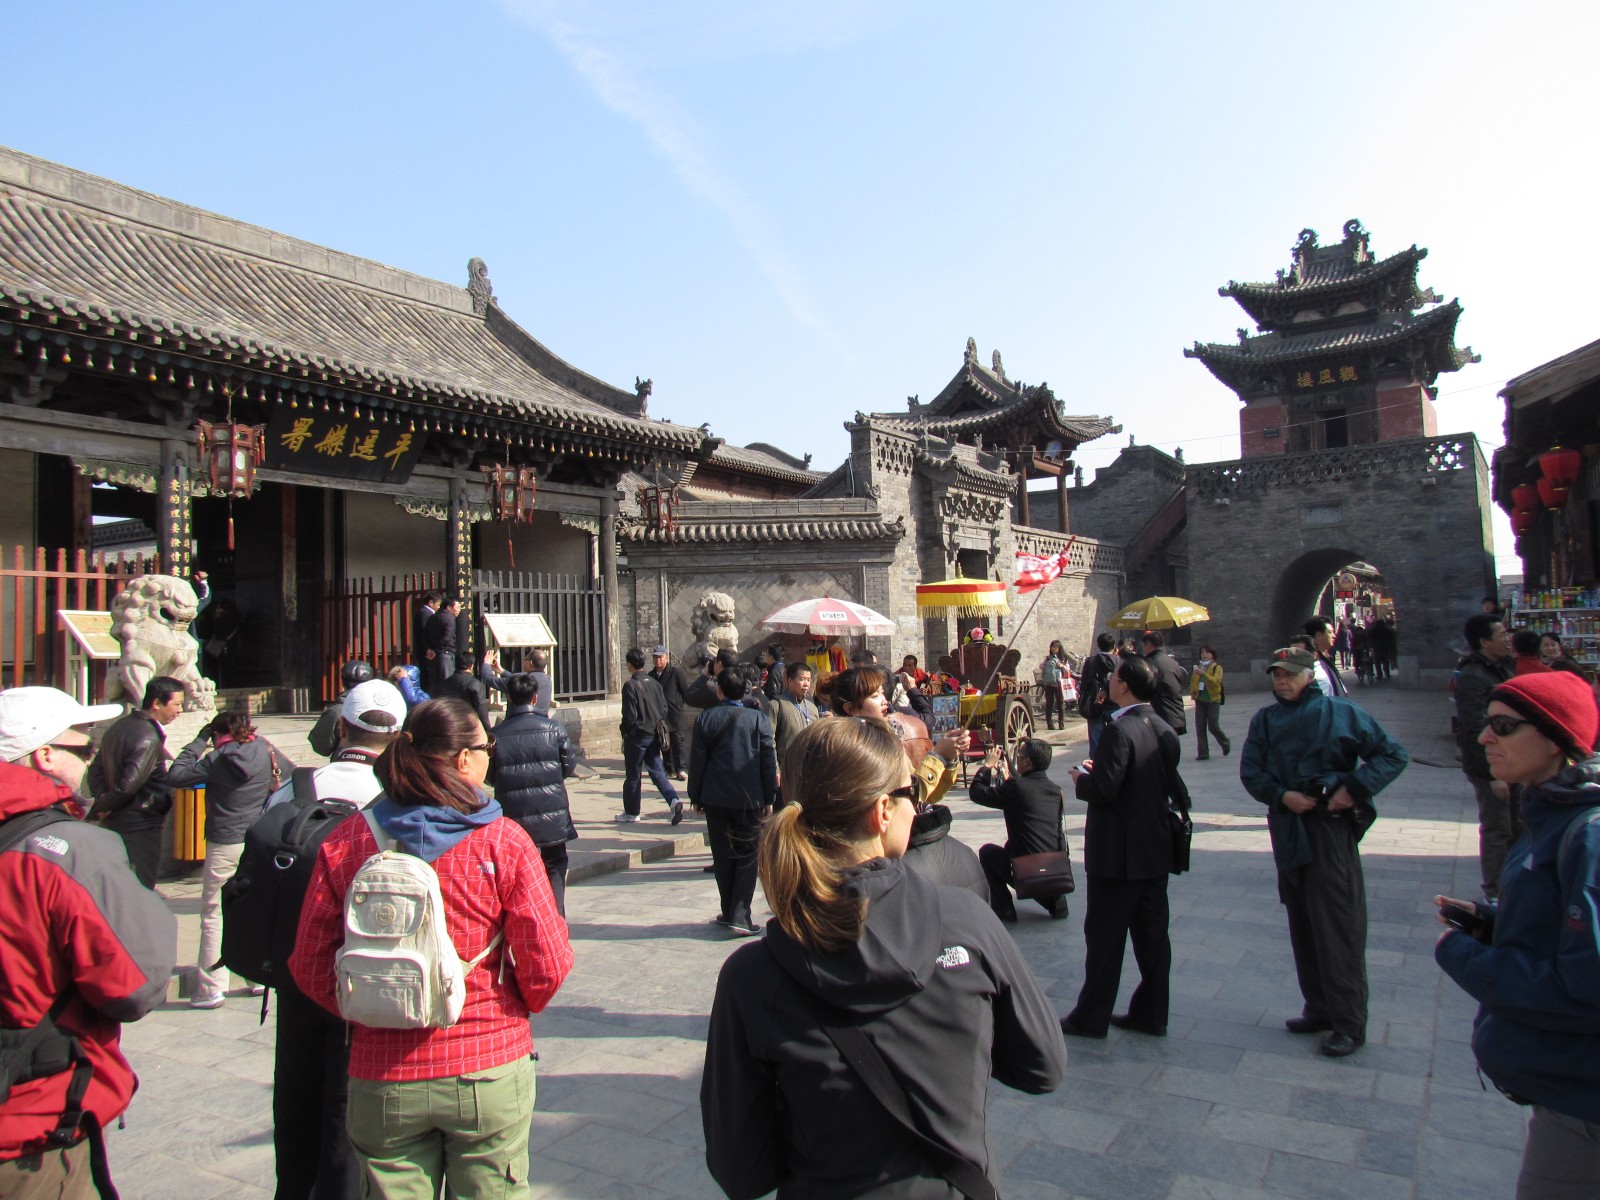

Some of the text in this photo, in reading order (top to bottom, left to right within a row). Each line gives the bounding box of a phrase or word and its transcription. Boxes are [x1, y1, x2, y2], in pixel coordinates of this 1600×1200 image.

[342, 752, 366, 761] Canon
[943, 947, 958, 955] THE
[936, 953, 960, 964] NORTH
[942, 960, 960, 968] FACE
